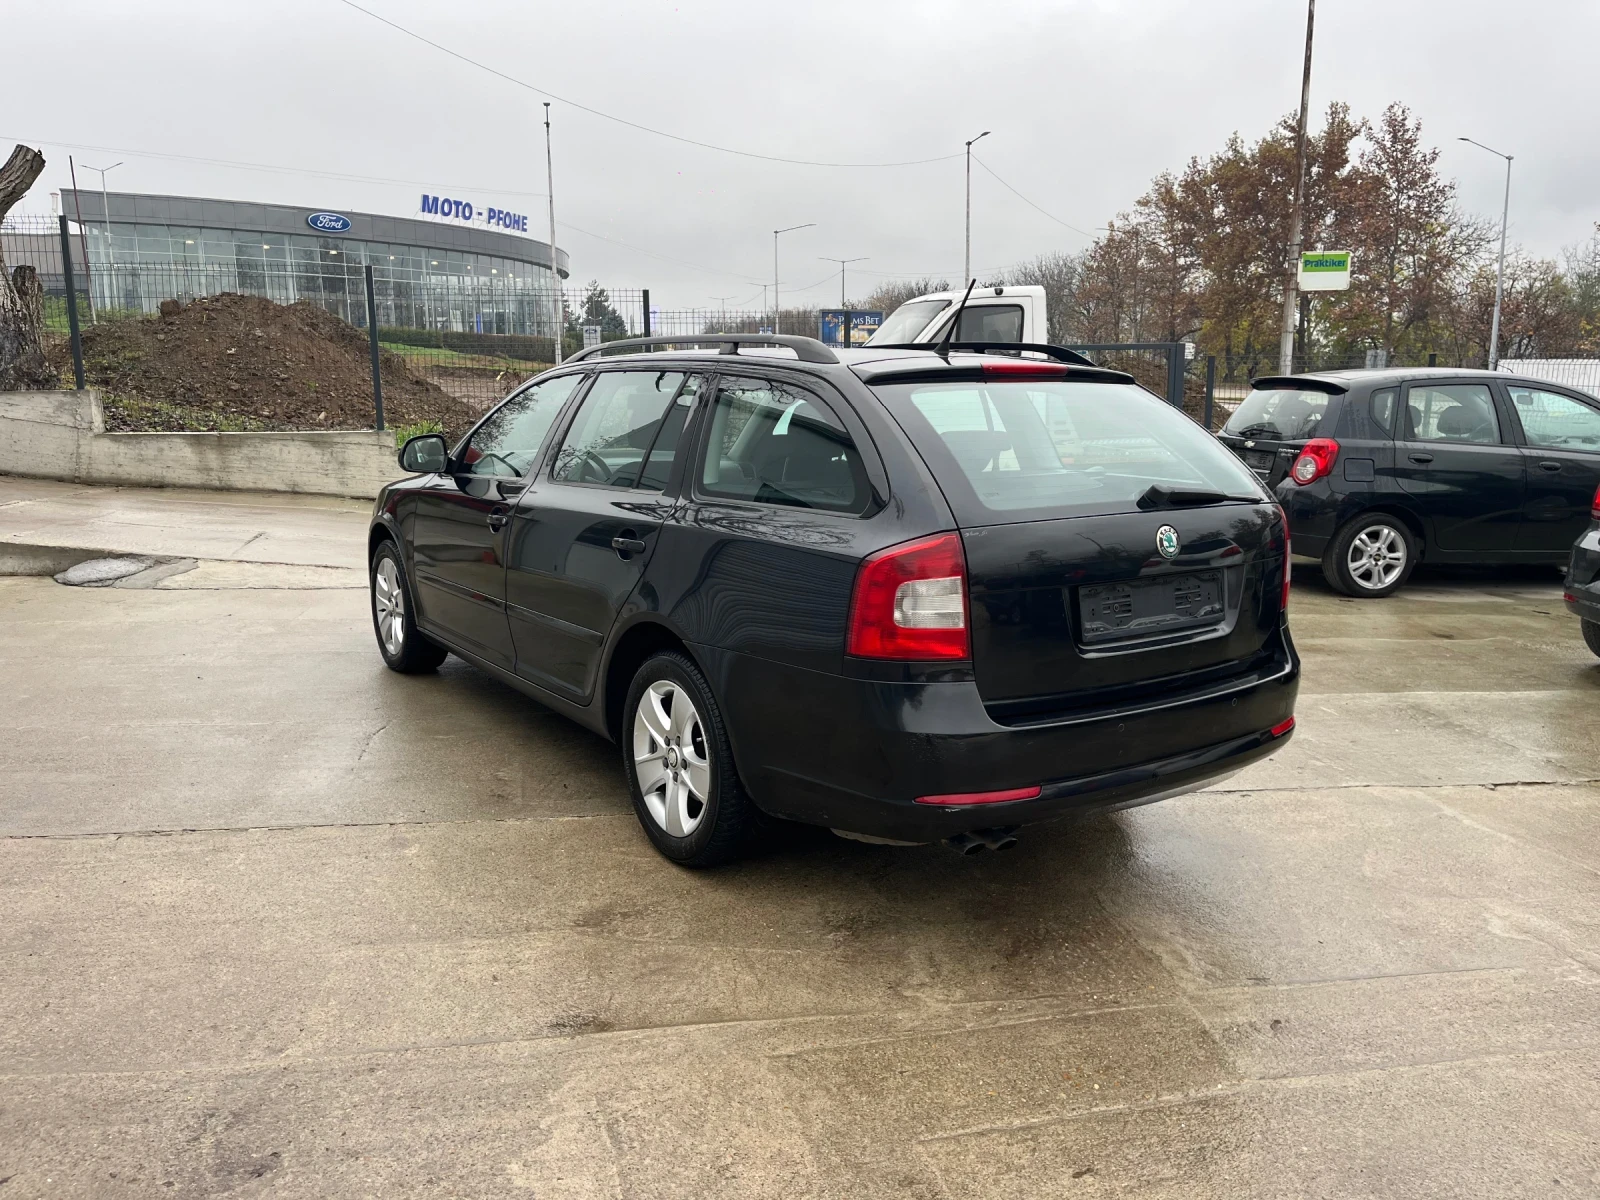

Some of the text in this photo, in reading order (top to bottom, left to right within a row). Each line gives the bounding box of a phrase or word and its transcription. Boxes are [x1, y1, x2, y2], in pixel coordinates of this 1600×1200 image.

[421, 194, 473, 220] MOTO
[487, 207, 528, 232] PFOHE
[317, 215, 343, 229] Ford
[1304, 258, 1347, 268] Praktiker
[838, 315, 864, 325] PMS
